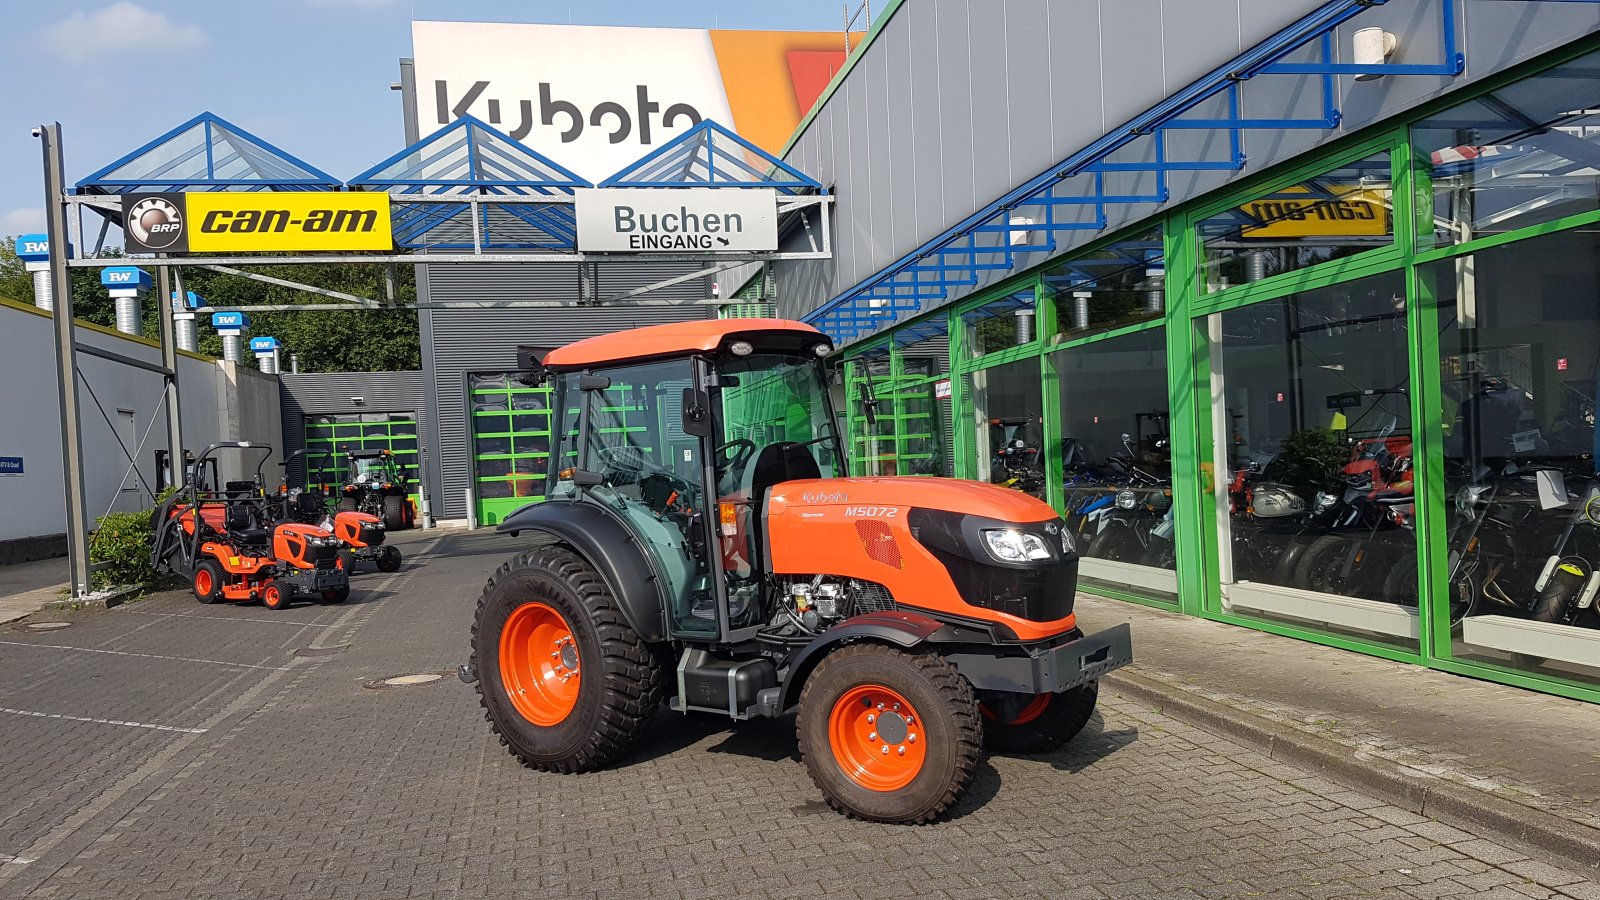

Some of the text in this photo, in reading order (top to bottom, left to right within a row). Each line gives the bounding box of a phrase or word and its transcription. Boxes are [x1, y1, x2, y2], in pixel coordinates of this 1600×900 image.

[200, 209, 377, 234] can-am
[614, 205, 743, 233] Buchen
[150, 223, 180, 233] BRP
[629, 234, 712, 249] EINGANG
[803, 490, 848, 503] Kubota
[845, 506, 898, 518] M5072
